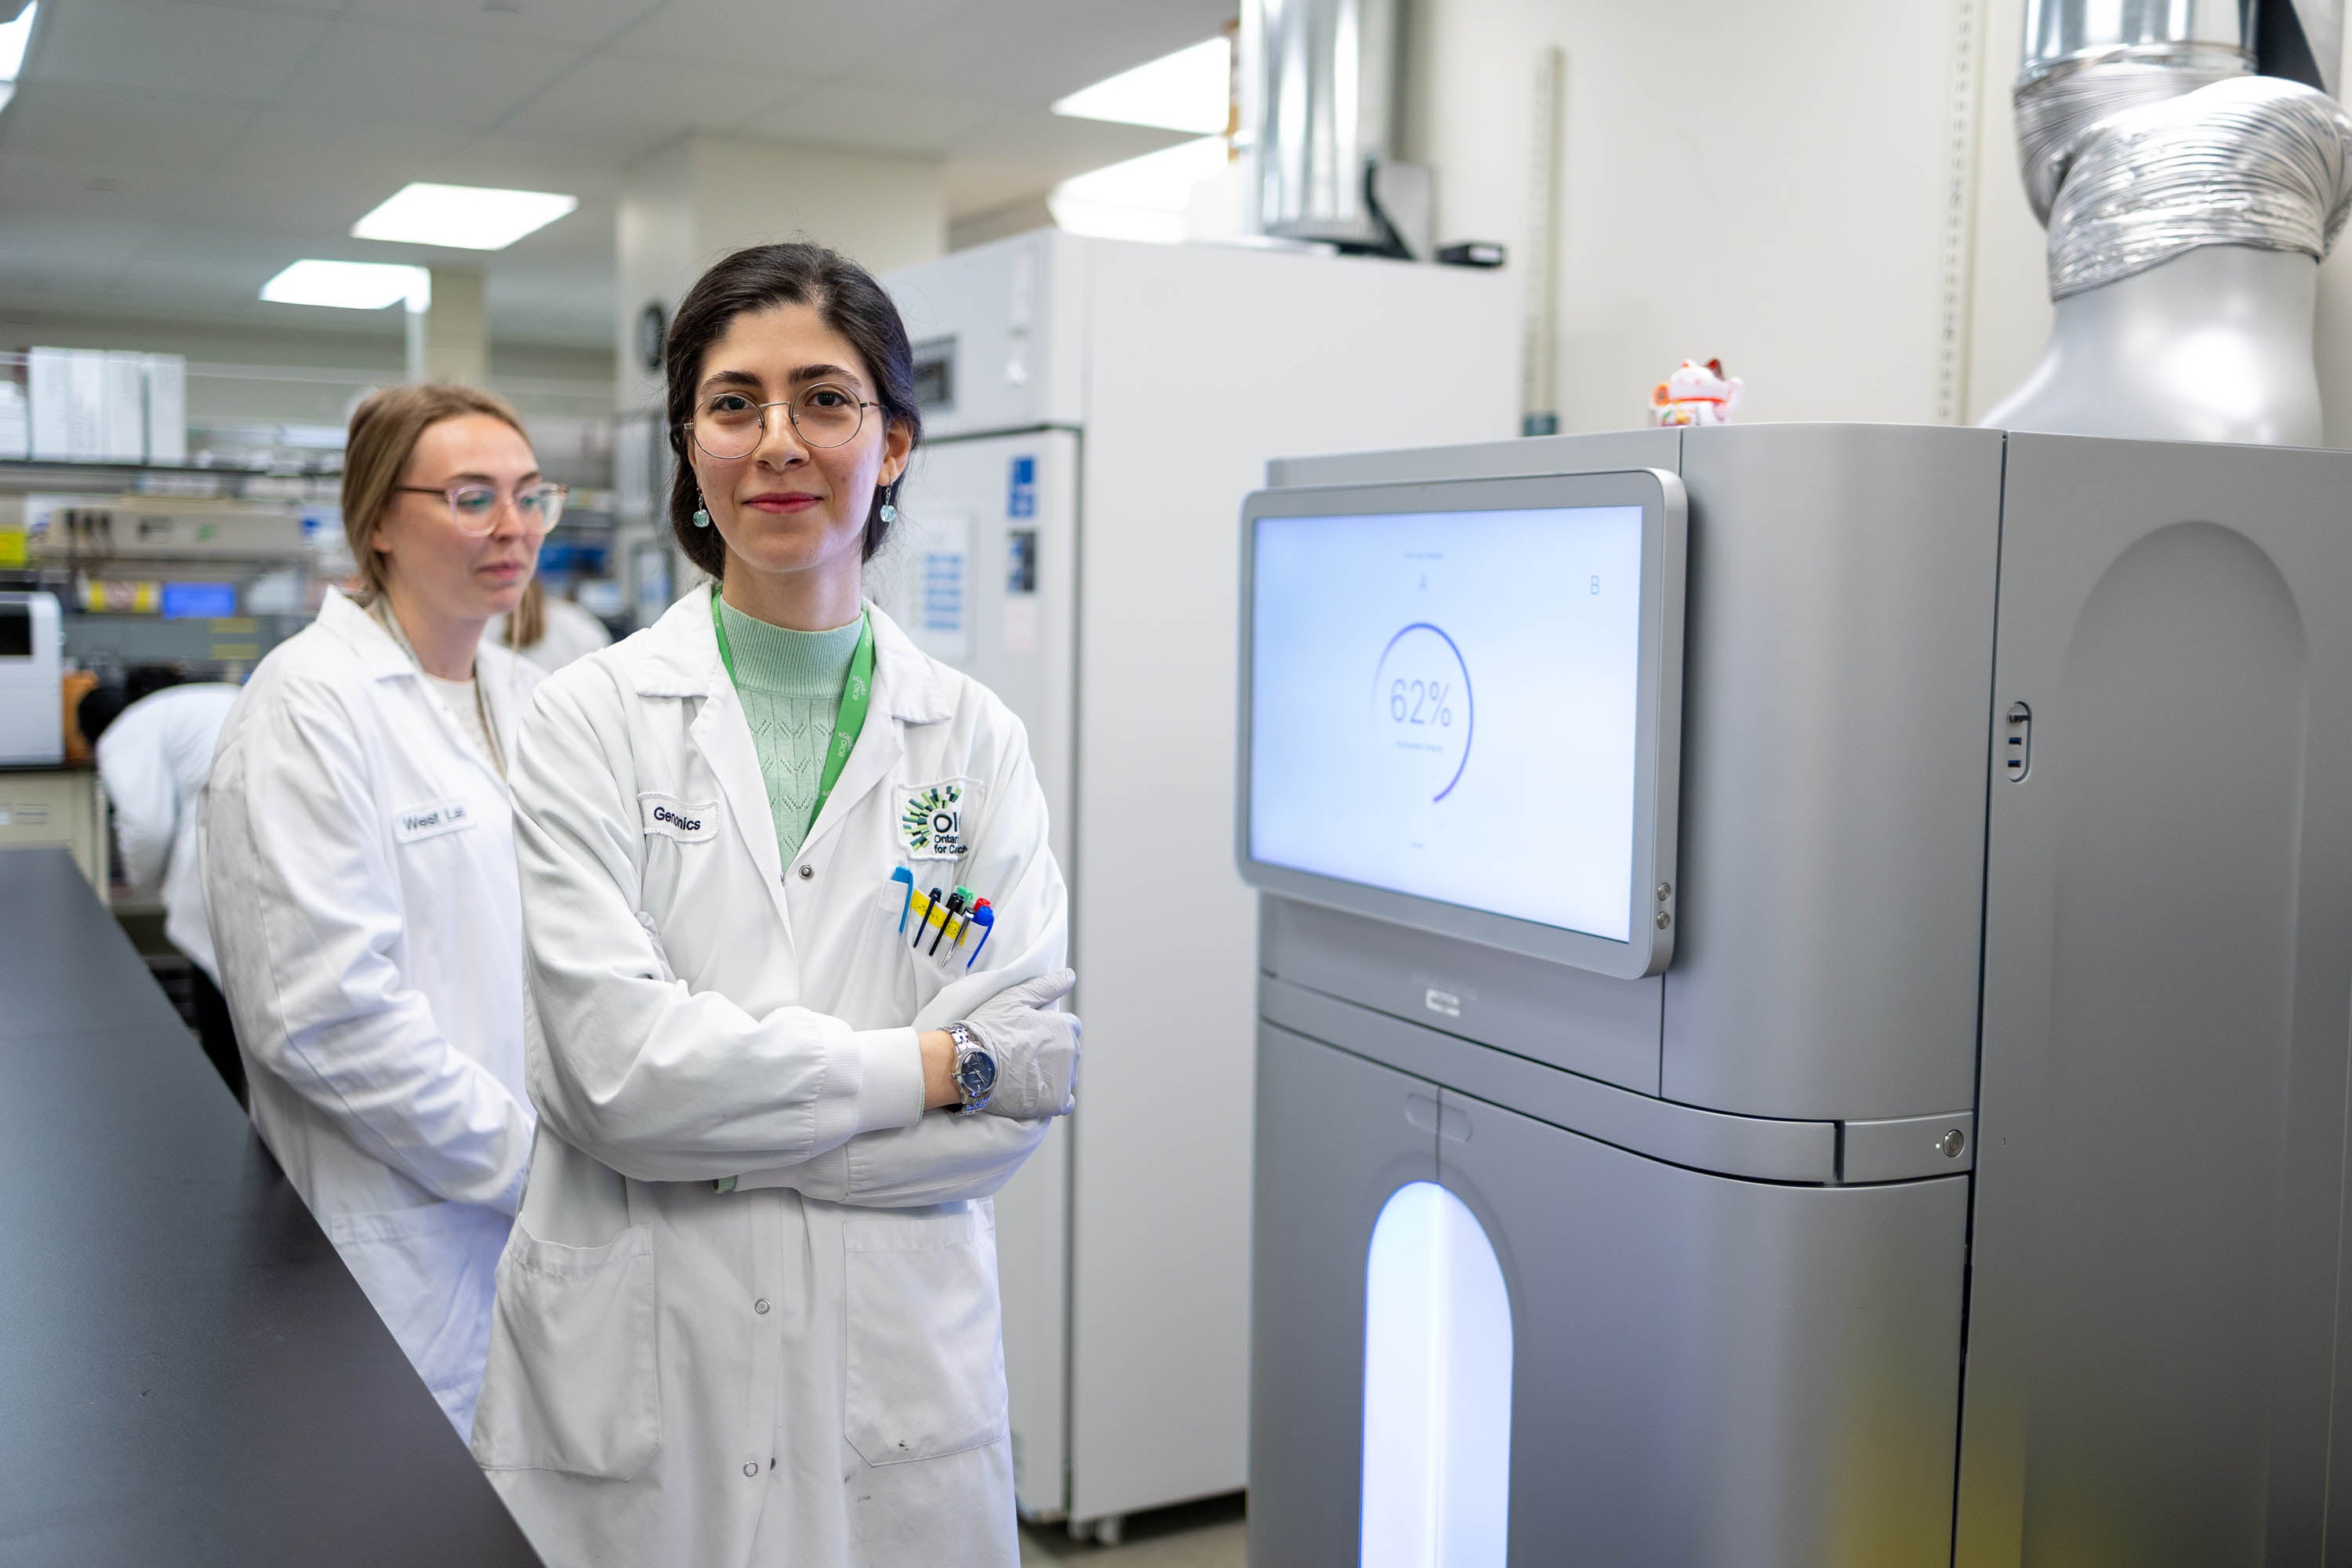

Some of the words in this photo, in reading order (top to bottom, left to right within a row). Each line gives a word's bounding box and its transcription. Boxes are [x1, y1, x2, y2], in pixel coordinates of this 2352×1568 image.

[1590, 575, 1600, 596] B
[1390, 679, 1451, 727] 62%
[837, 739, 848, 758] OICR
[934, 811, 959, 833] OI
[934, 844, 947, 854] for
